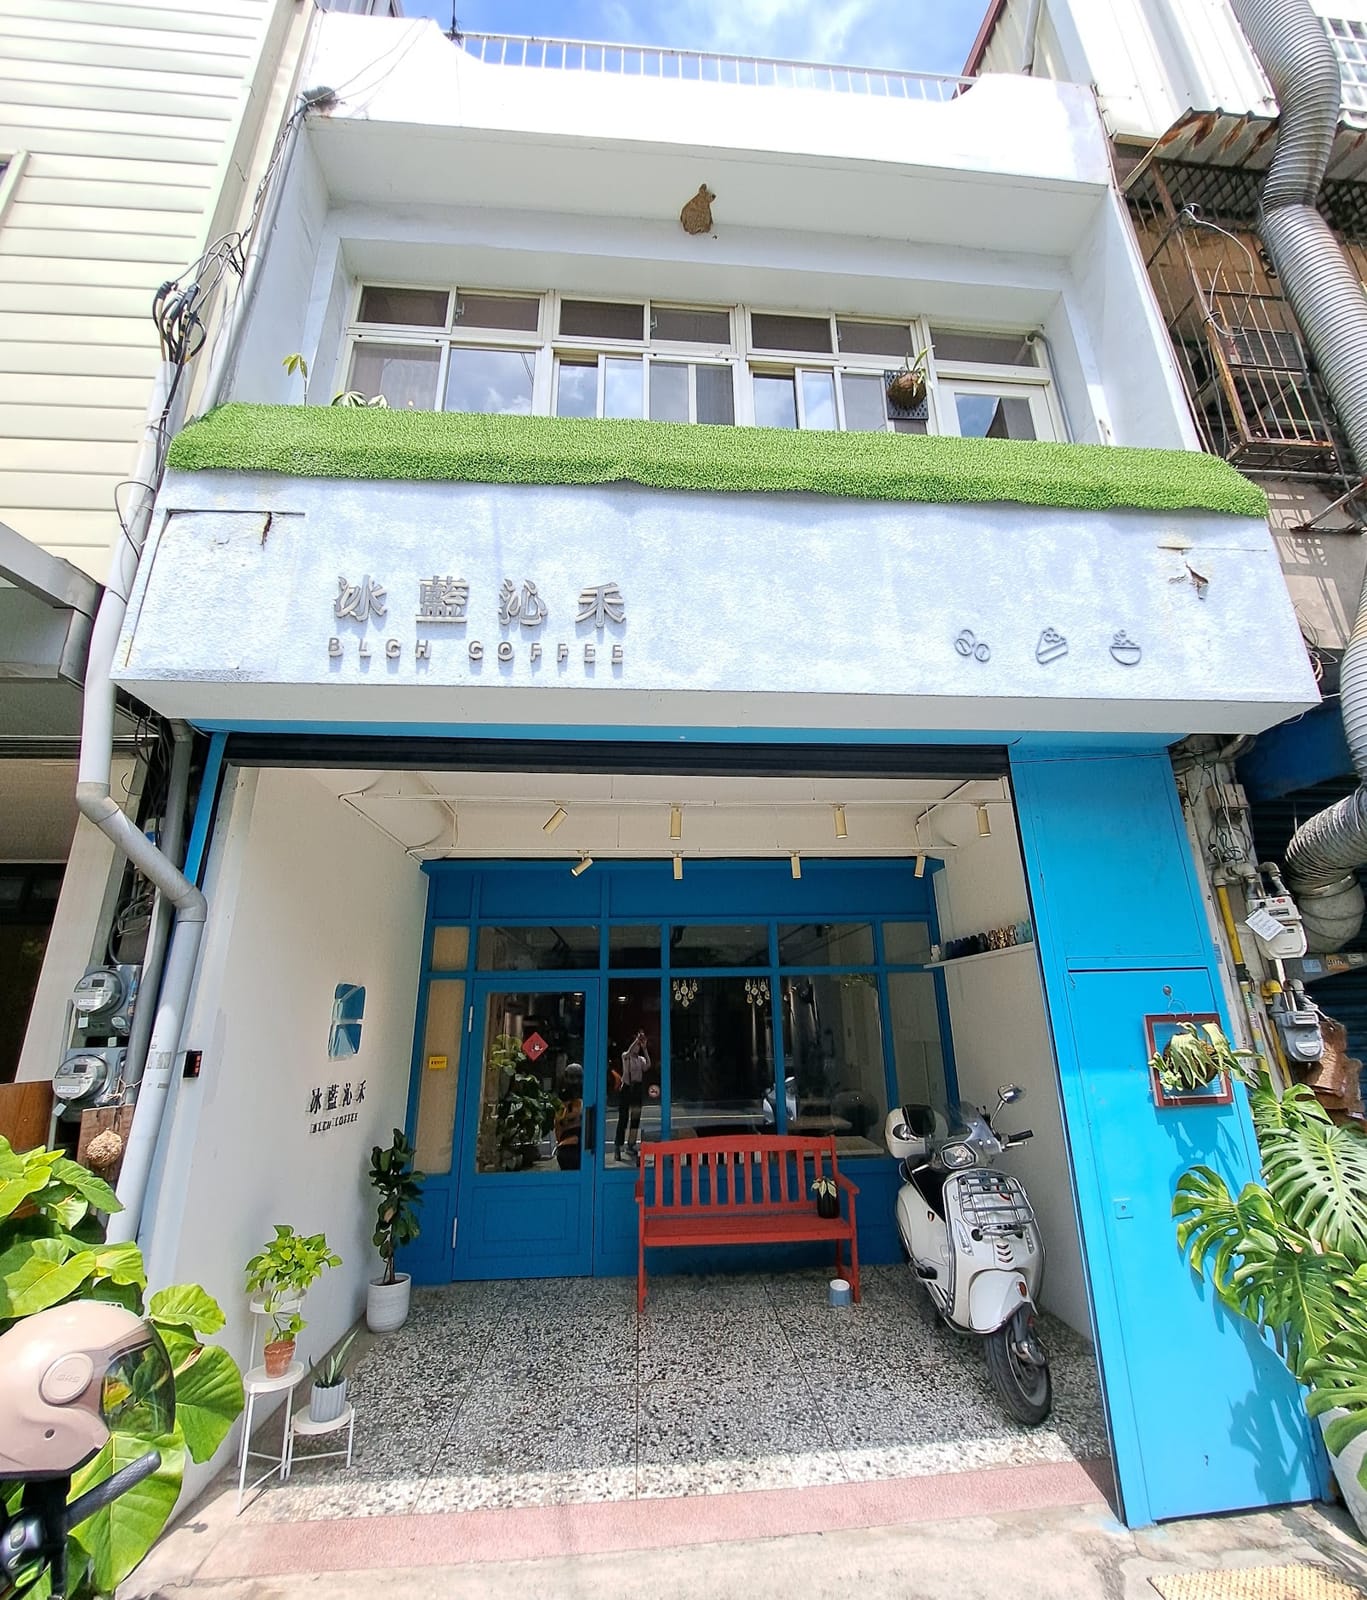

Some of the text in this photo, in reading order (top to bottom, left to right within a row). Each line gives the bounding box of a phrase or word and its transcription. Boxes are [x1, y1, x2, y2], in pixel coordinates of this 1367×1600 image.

[333, 574, 627, 628] 冰藍沁禾
[328, 637, 624, 663] BLCH COFFEE
[307, 1080, 366, 1114] 冰藍沁禾
[334, 1113, 358, 1126] COFFEE
